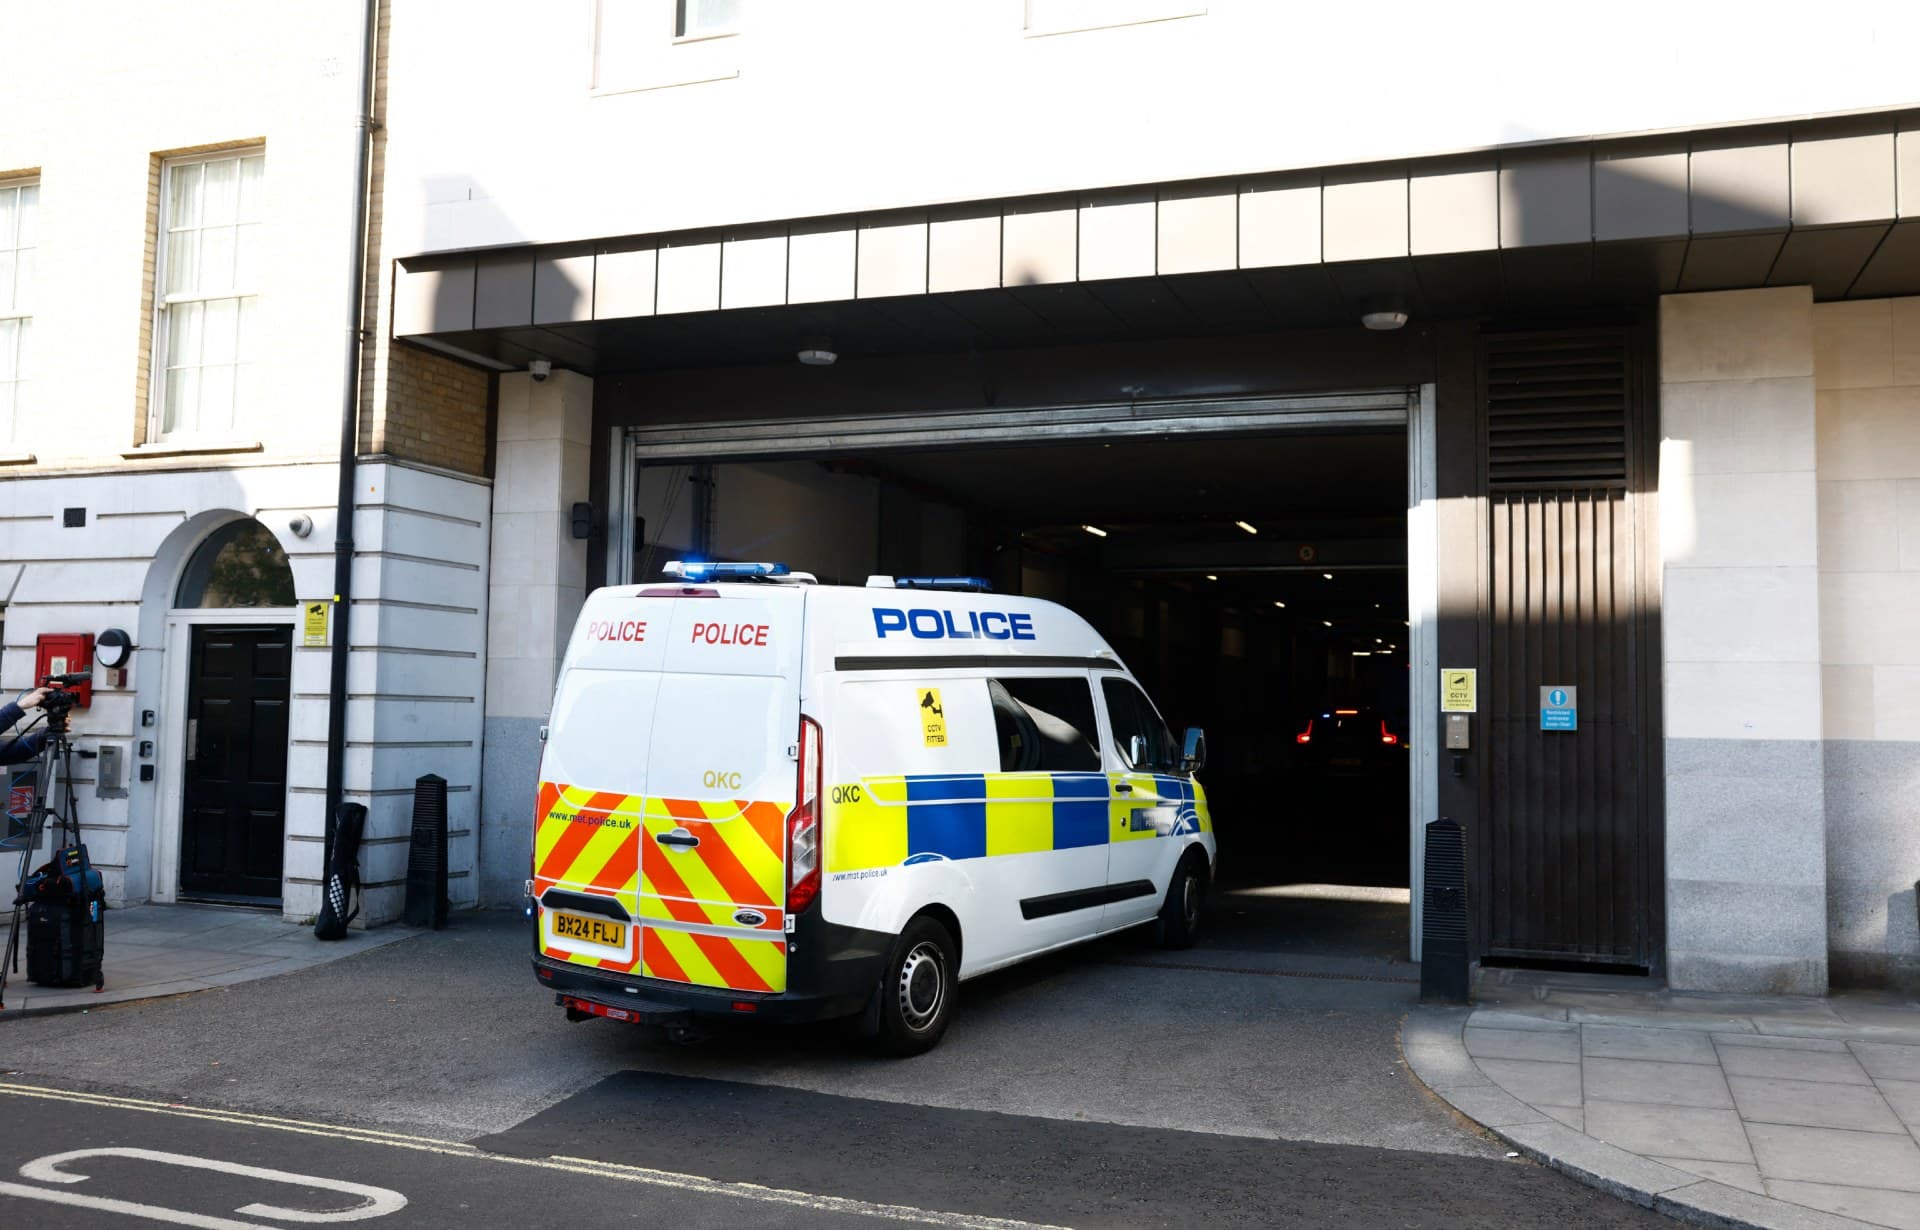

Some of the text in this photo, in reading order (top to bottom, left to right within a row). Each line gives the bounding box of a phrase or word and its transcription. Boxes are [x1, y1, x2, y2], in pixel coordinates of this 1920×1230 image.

[587, 621, 647, 642] POLICE
[872, 608, 1036, 640] POLICE
[692, 623, 769, 646] POLICE
[927, 724, 942, 732] CCTV
[926, 735, 944, 743] FITTED
[703, 770, 742, 790] QKC
[832, 785, 860, 804] QKC
[549, 811, 631, 829] www.met.police.uk
[557, 915, 619, 943] BX24 FLJ
